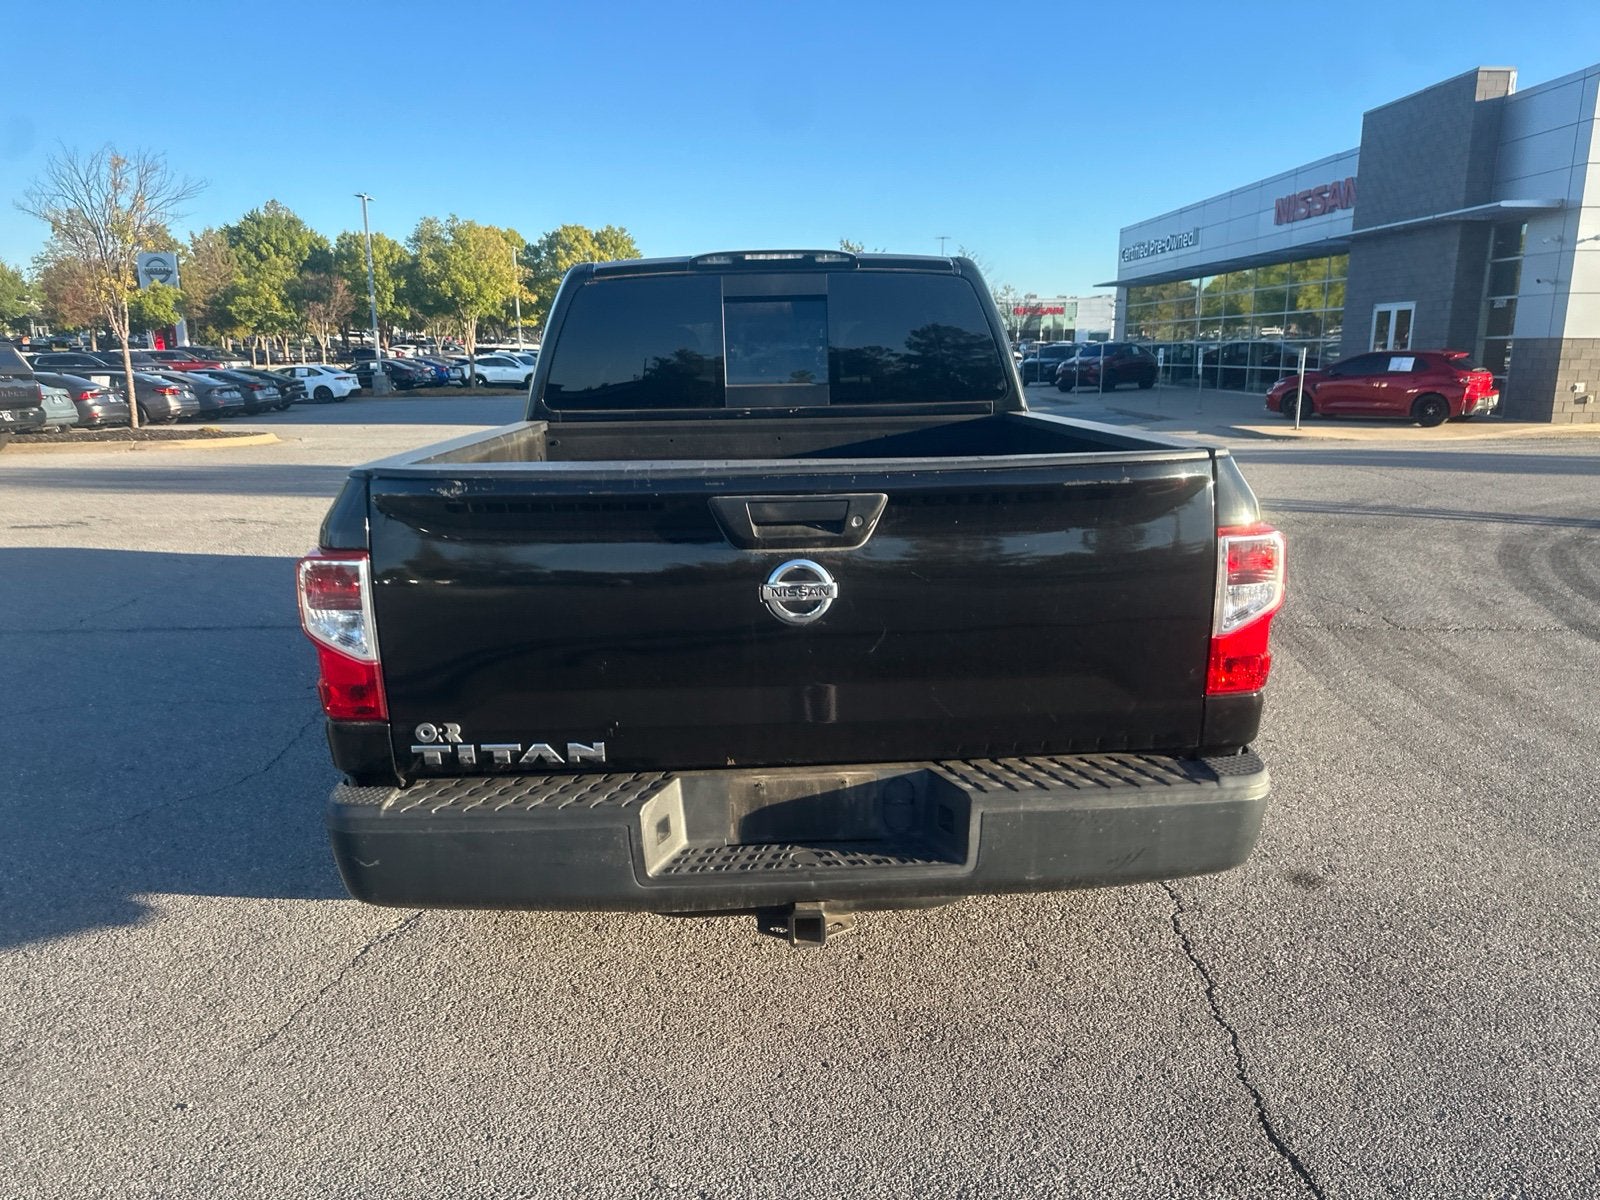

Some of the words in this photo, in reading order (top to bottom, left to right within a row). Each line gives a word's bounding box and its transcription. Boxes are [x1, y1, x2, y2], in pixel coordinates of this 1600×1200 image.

[1273, 176, 1358, 225] NISSAN
[1121, 239, 1148, 262] Certified
[1149, 227, 1200, 254] Pre-Owned
[770, 586, 830, 598] NISSAN
[410, 741, 606, 766] TITAN
